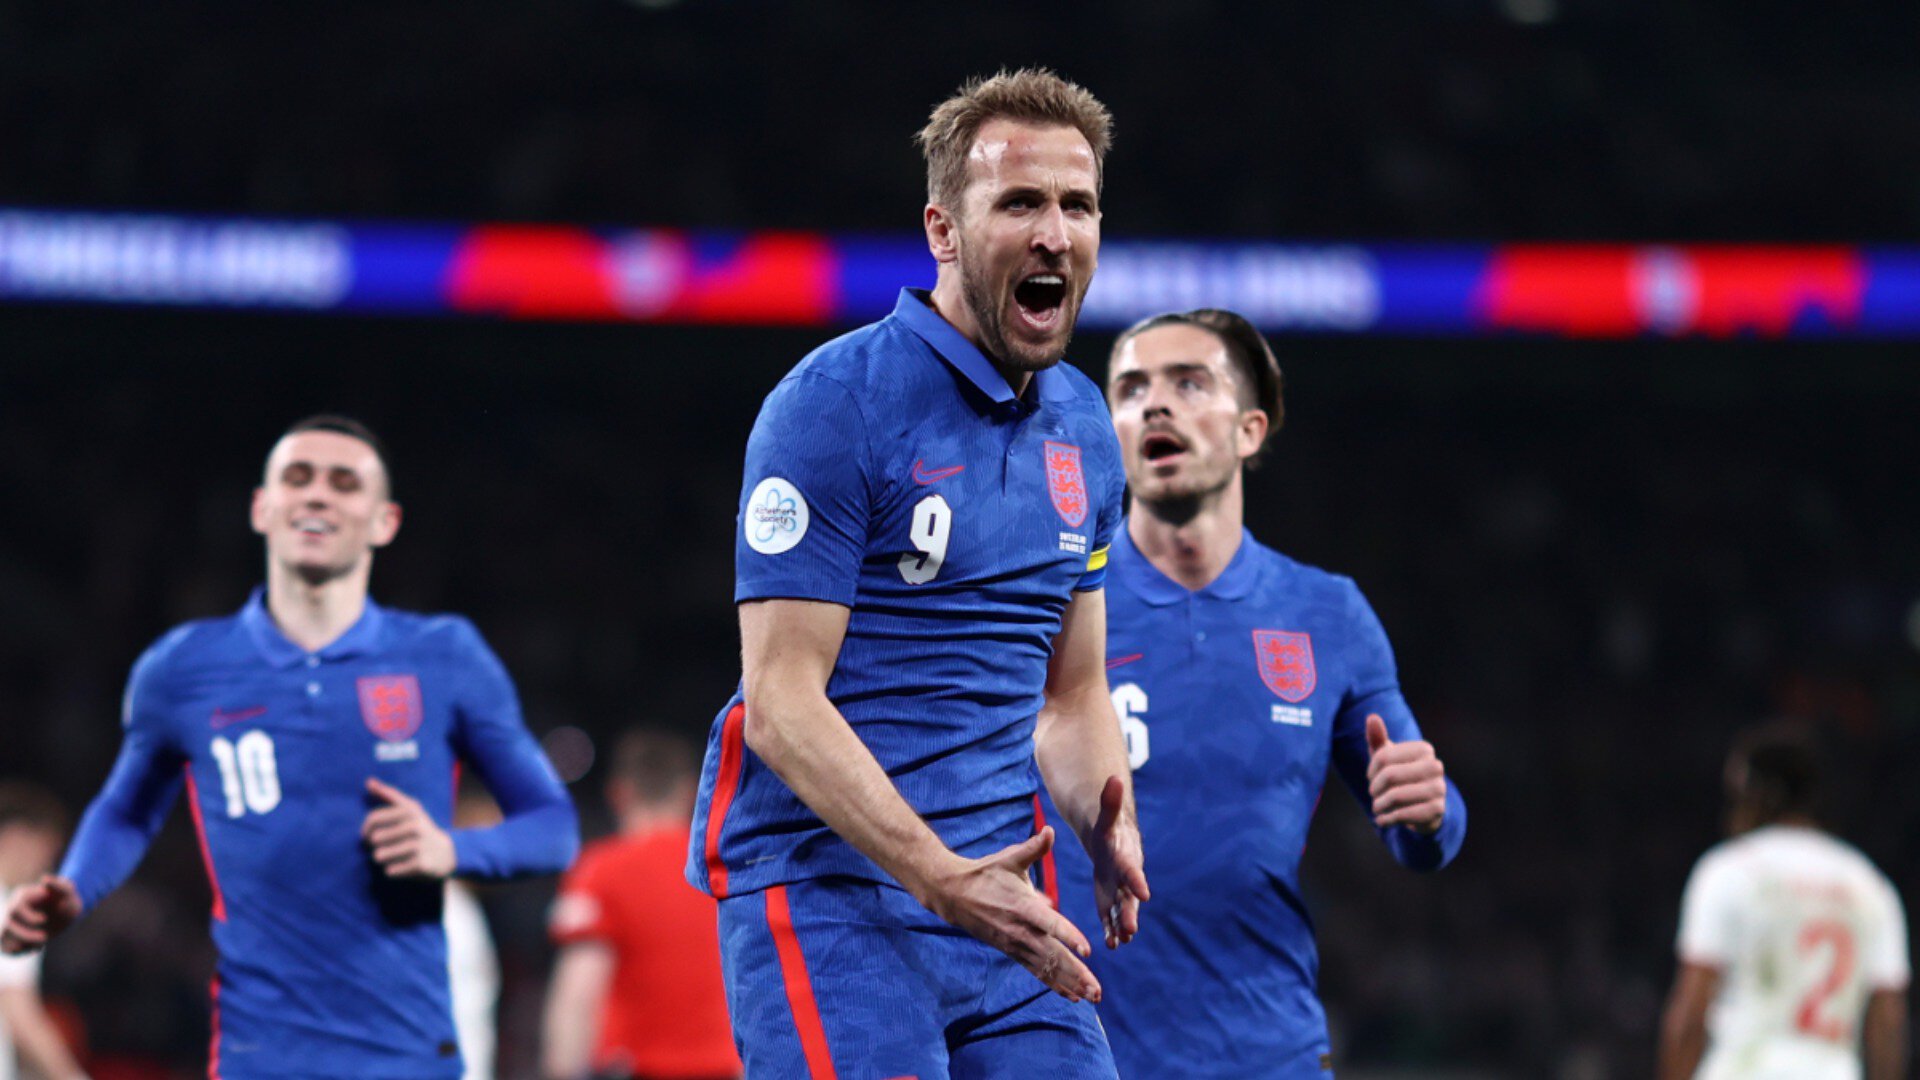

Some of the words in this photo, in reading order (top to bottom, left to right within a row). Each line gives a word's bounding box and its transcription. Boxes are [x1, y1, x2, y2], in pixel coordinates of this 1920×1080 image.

[897, 494, 952, 585] 9
[1110, 683, 1149, 770] 6
[211, 730, 282, 818] 10
[1796, 918, 1855, 1042] 2
